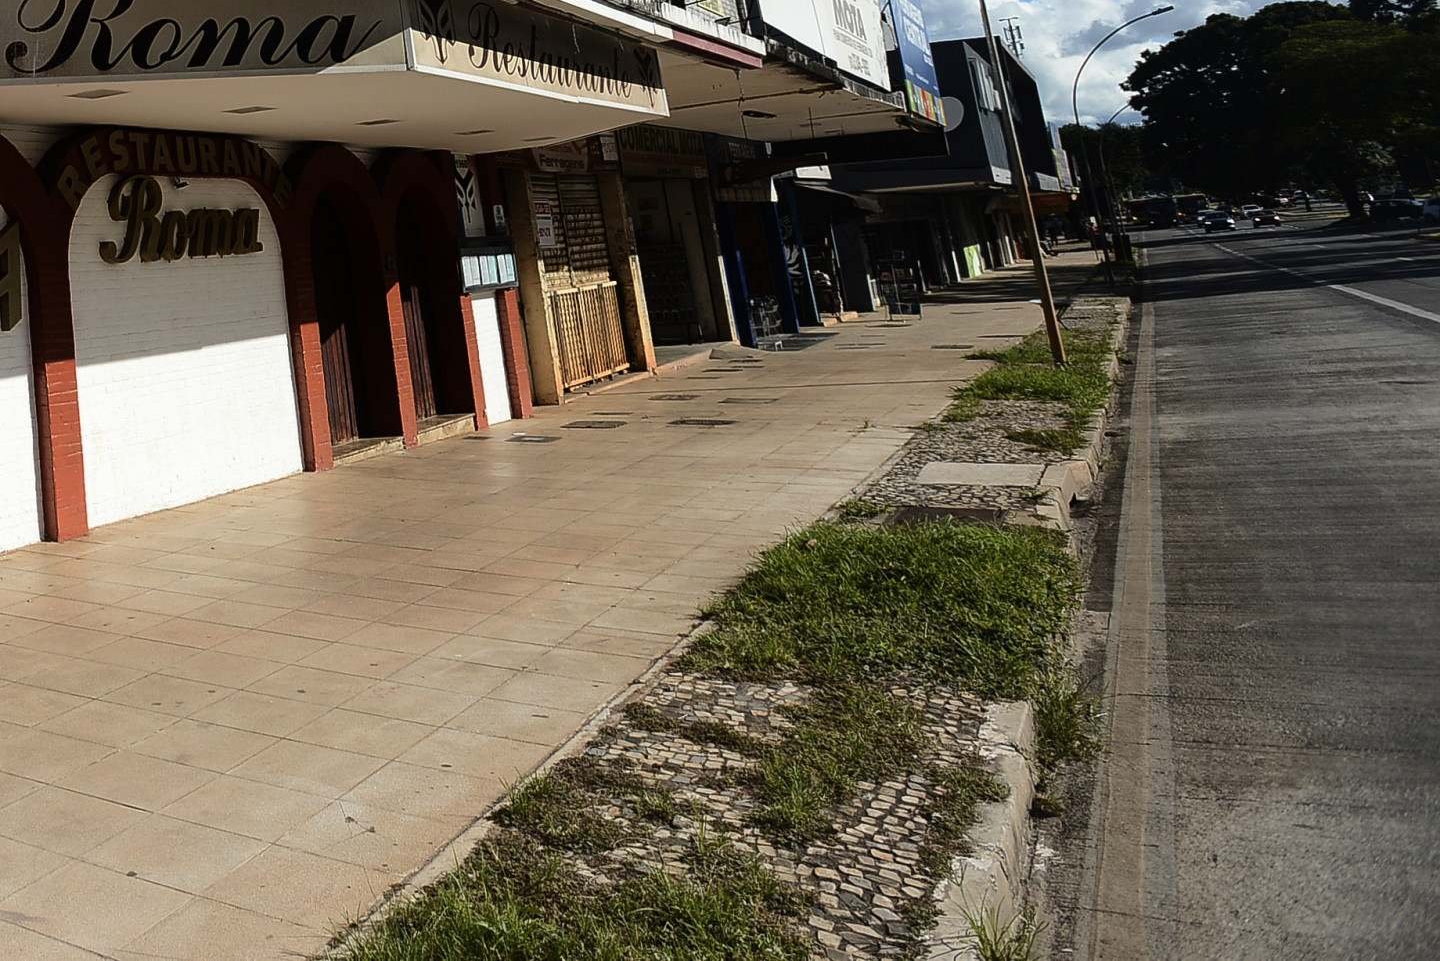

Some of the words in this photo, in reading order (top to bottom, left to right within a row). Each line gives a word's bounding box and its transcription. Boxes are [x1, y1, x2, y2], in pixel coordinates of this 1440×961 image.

[467, 2, 632, 98] Restaurante
[57, 132, 293, 210] RESTAURANTE
[99, 175, 263, 264] Roma
